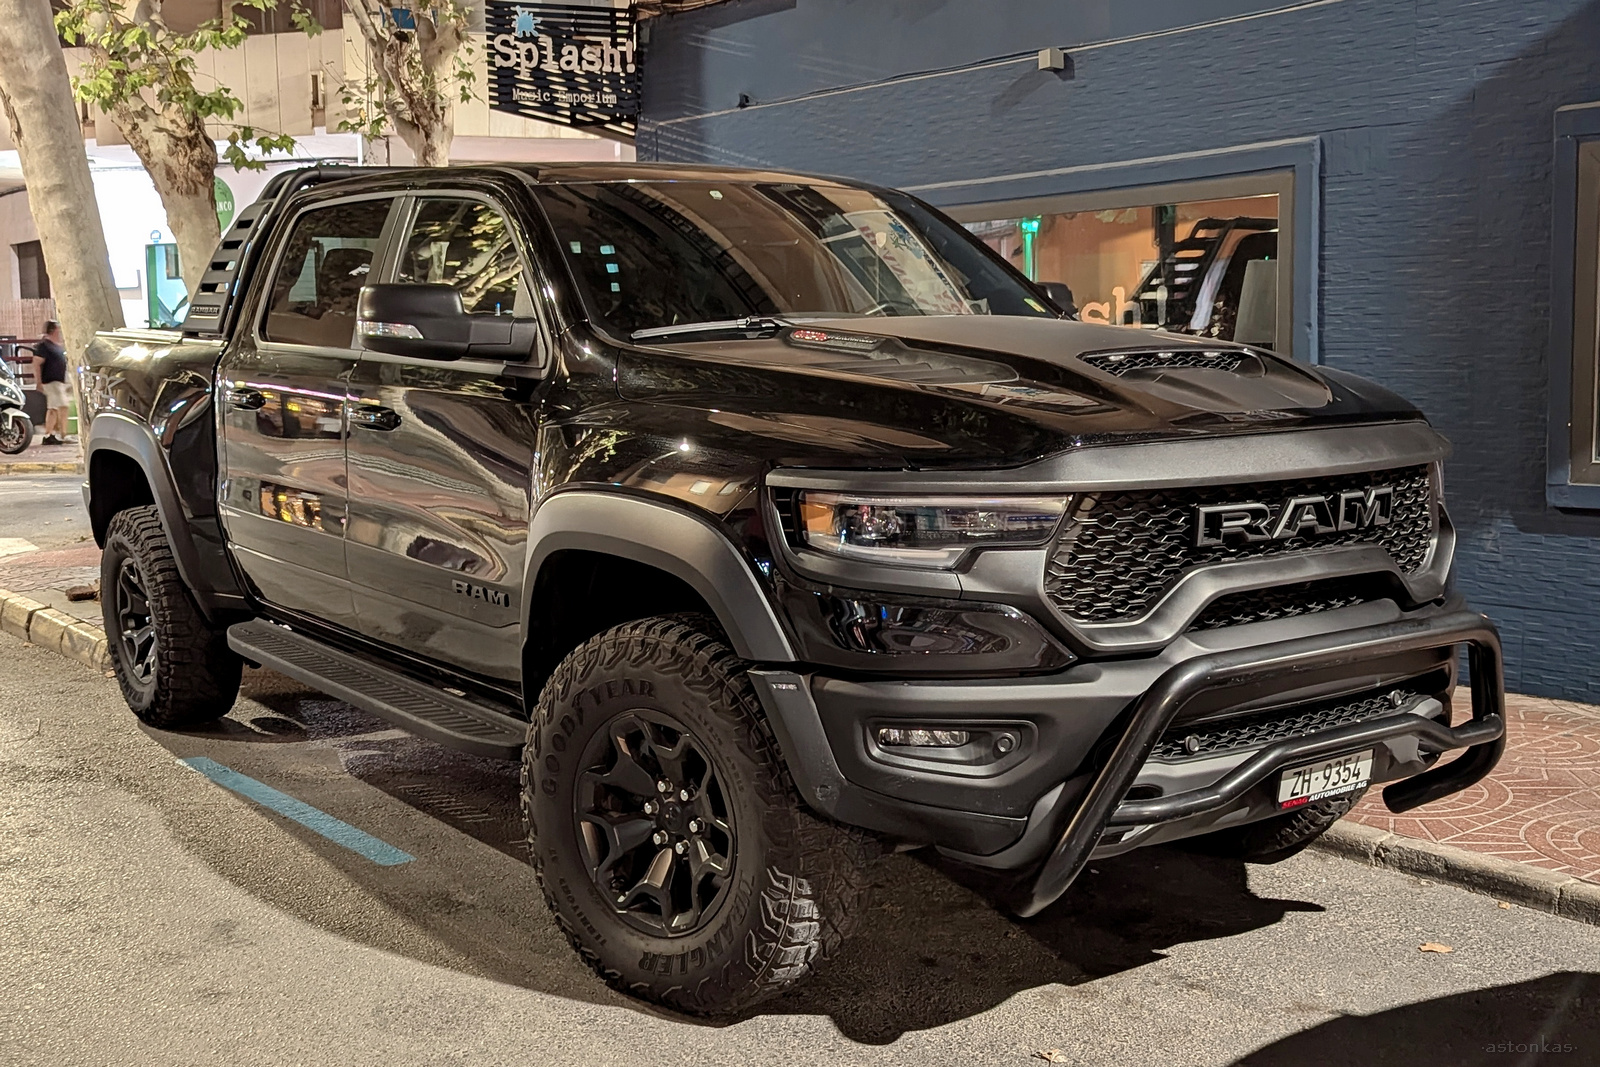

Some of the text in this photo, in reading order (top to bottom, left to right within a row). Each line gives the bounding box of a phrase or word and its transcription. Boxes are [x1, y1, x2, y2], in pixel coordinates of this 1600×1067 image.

[493, 33, 636, 78] Splash!
[511, 88, 618, 106] Music Emporium
[1196, 485, 1394, 547] RAM
[451, 579, 510, 608] RAM
[1308, 784, 1355, 802] AUTOMOBILE
[1355, 780, 1367, 789] AG
